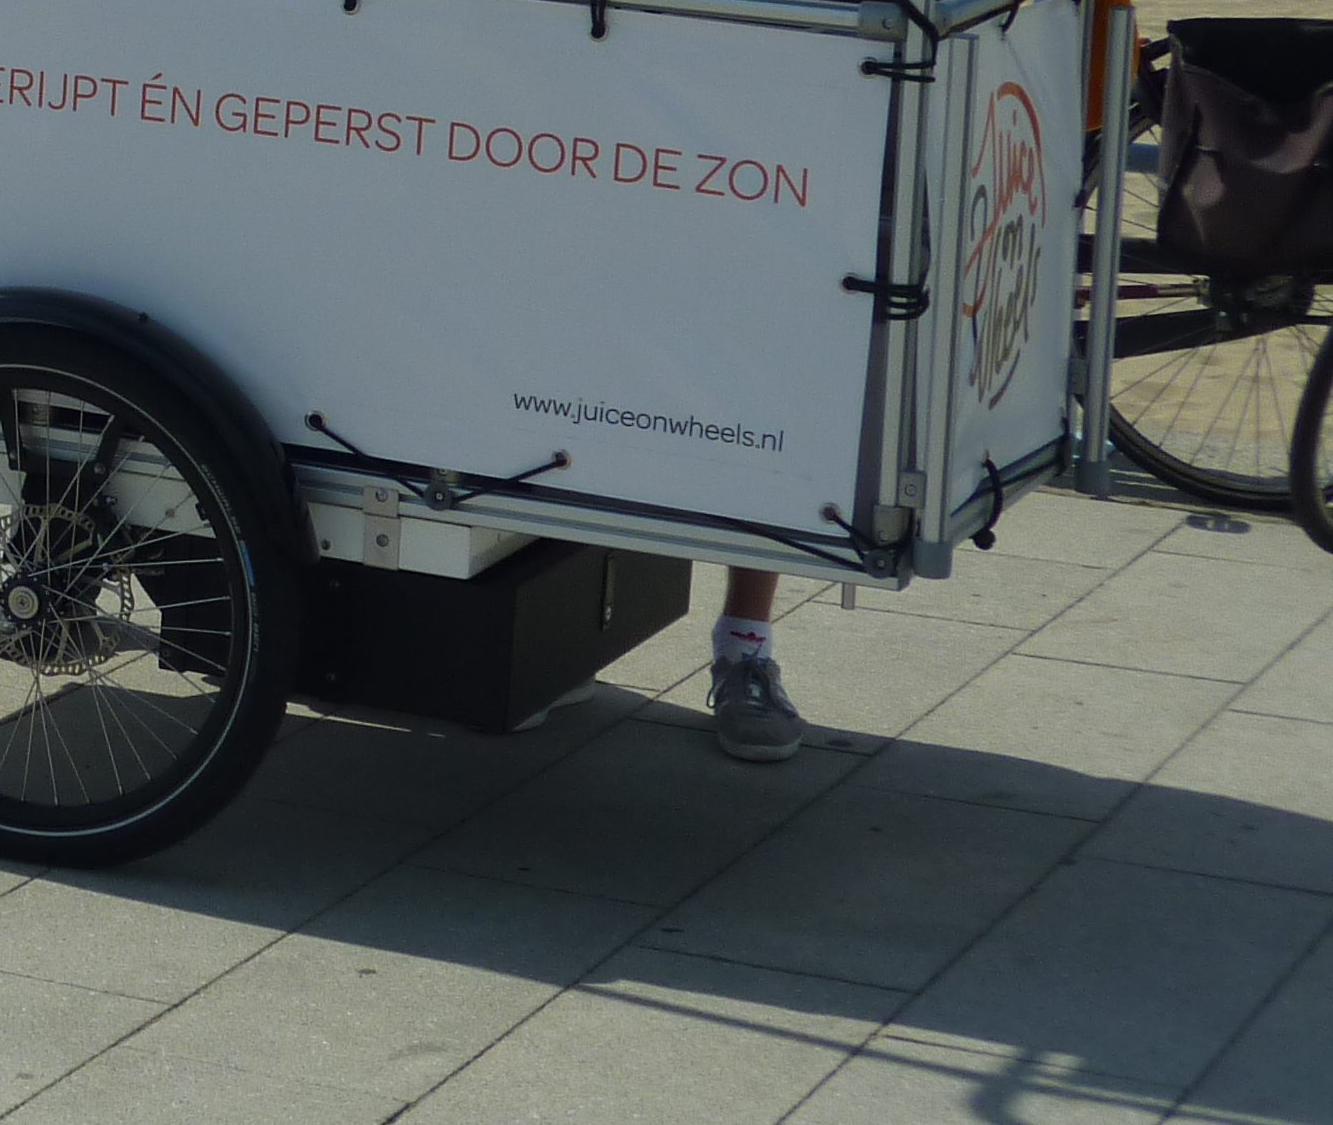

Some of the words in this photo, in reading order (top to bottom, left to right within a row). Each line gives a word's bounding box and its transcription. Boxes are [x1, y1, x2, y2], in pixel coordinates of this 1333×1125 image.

[140, 72, 202, 128] ÉN
[214, 92, 437, 156] GEPERST
[447, 121, 599, 179] DOOR
[613, 143, 682, 191] DE
[695, 154, 808, 208] ZON
[962, 90, 1038, 317] Juice
[513, 393, 784, 452] www.juiceonwheels.nl
